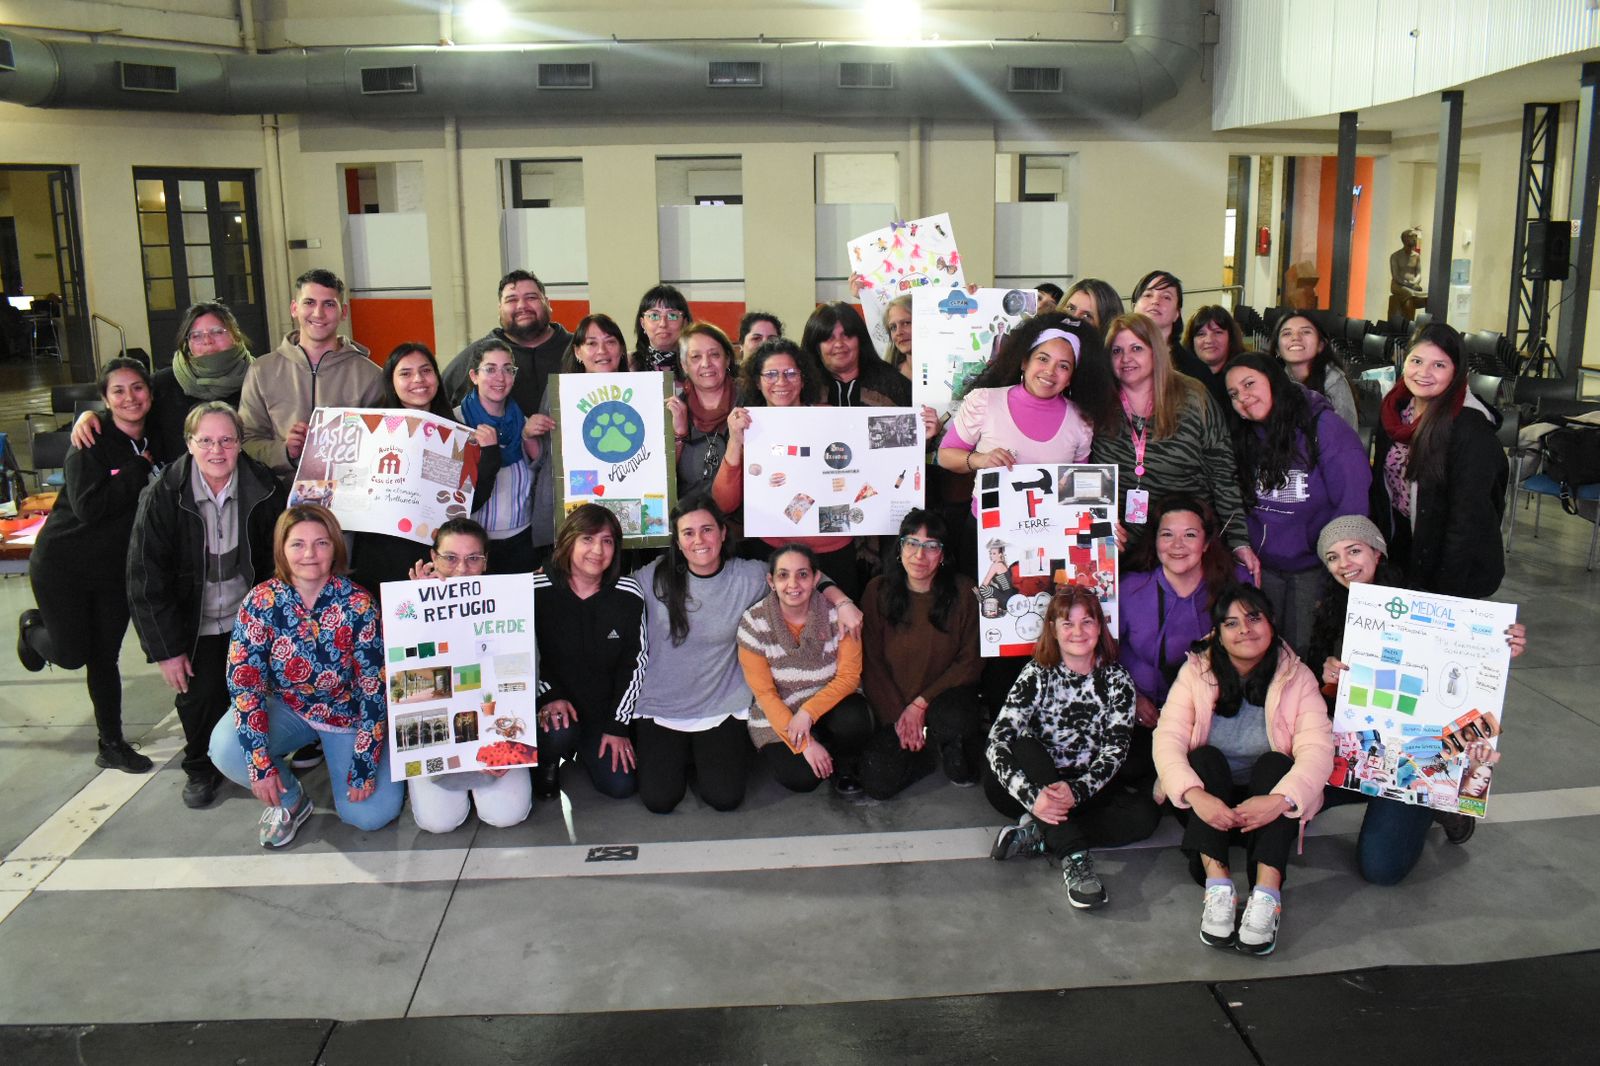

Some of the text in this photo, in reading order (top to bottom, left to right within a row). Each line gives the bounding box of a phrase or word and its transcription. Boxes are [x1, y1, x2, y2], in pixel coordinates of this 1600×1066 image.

[576, 385, 633, 414] MUNDO
[608, 445, 652, 482] Animal
[1018, 518, 1050, 529] FERRE
[418, 581, 482, 603] VIVERO
[424, 599, 496, 623] REFUGIO
[1347, 612, 1386, 631] FARM
[473, 618, 526, 636] VERDE
